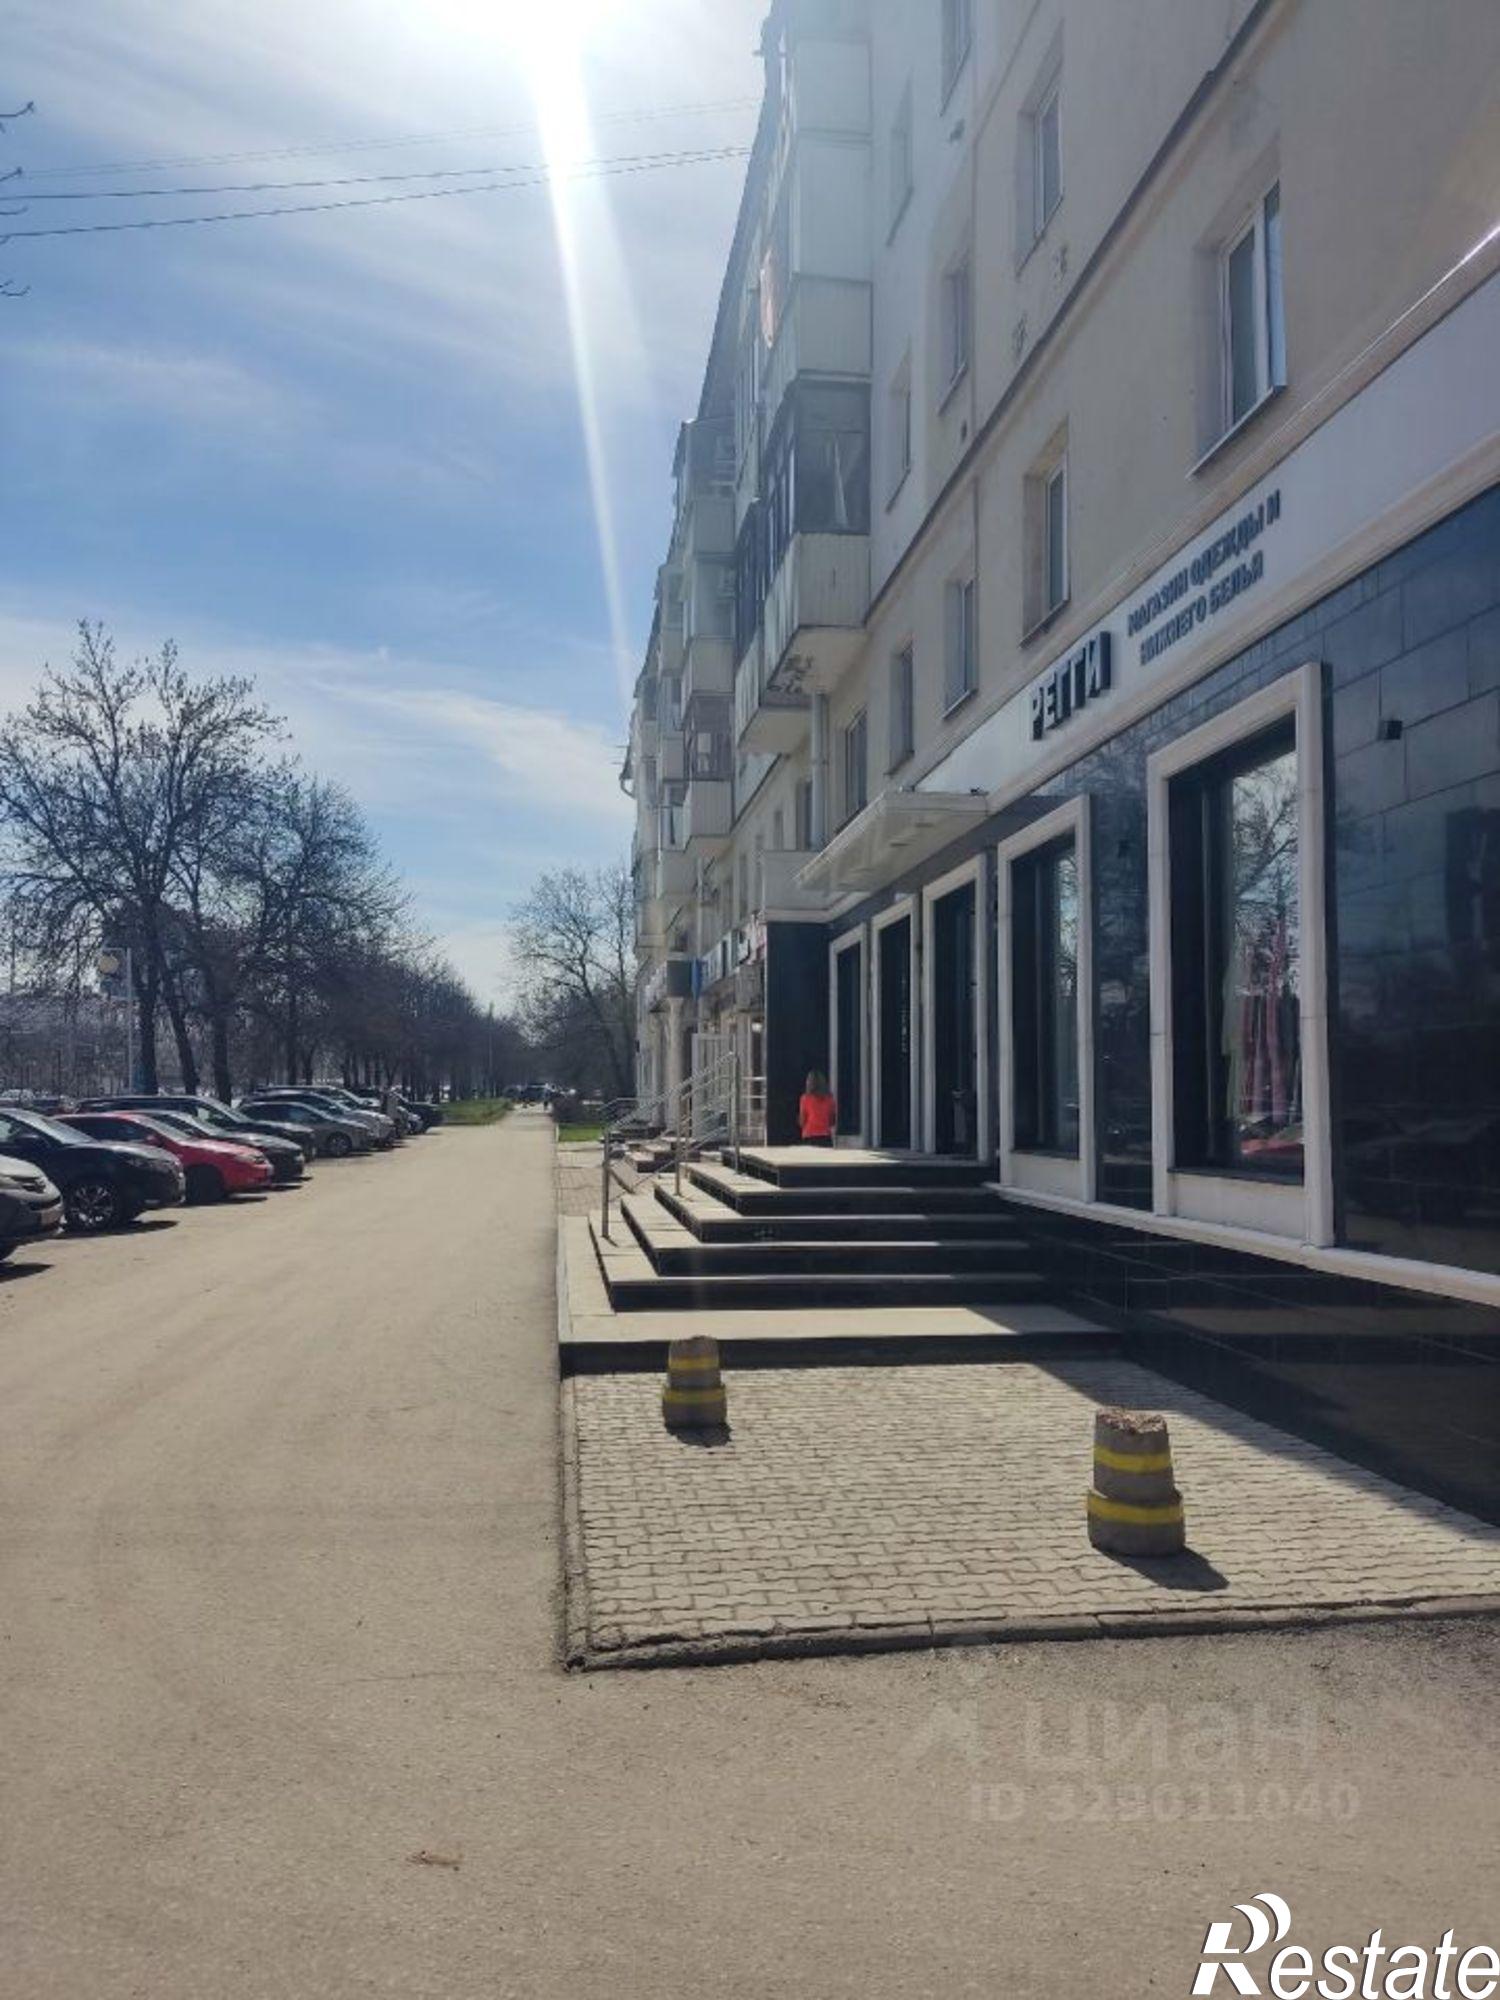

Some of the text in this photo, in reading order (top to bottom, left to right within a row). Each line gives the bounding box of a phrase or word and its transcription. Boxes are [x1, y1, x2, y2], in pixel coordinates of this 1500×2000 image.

[1128, 488, 1281, 637] МАГАЗИН ОДЕЖДЫ И
[1140, 550, 1264, 666] НИЖНЕГО БЕЛЬЯ
